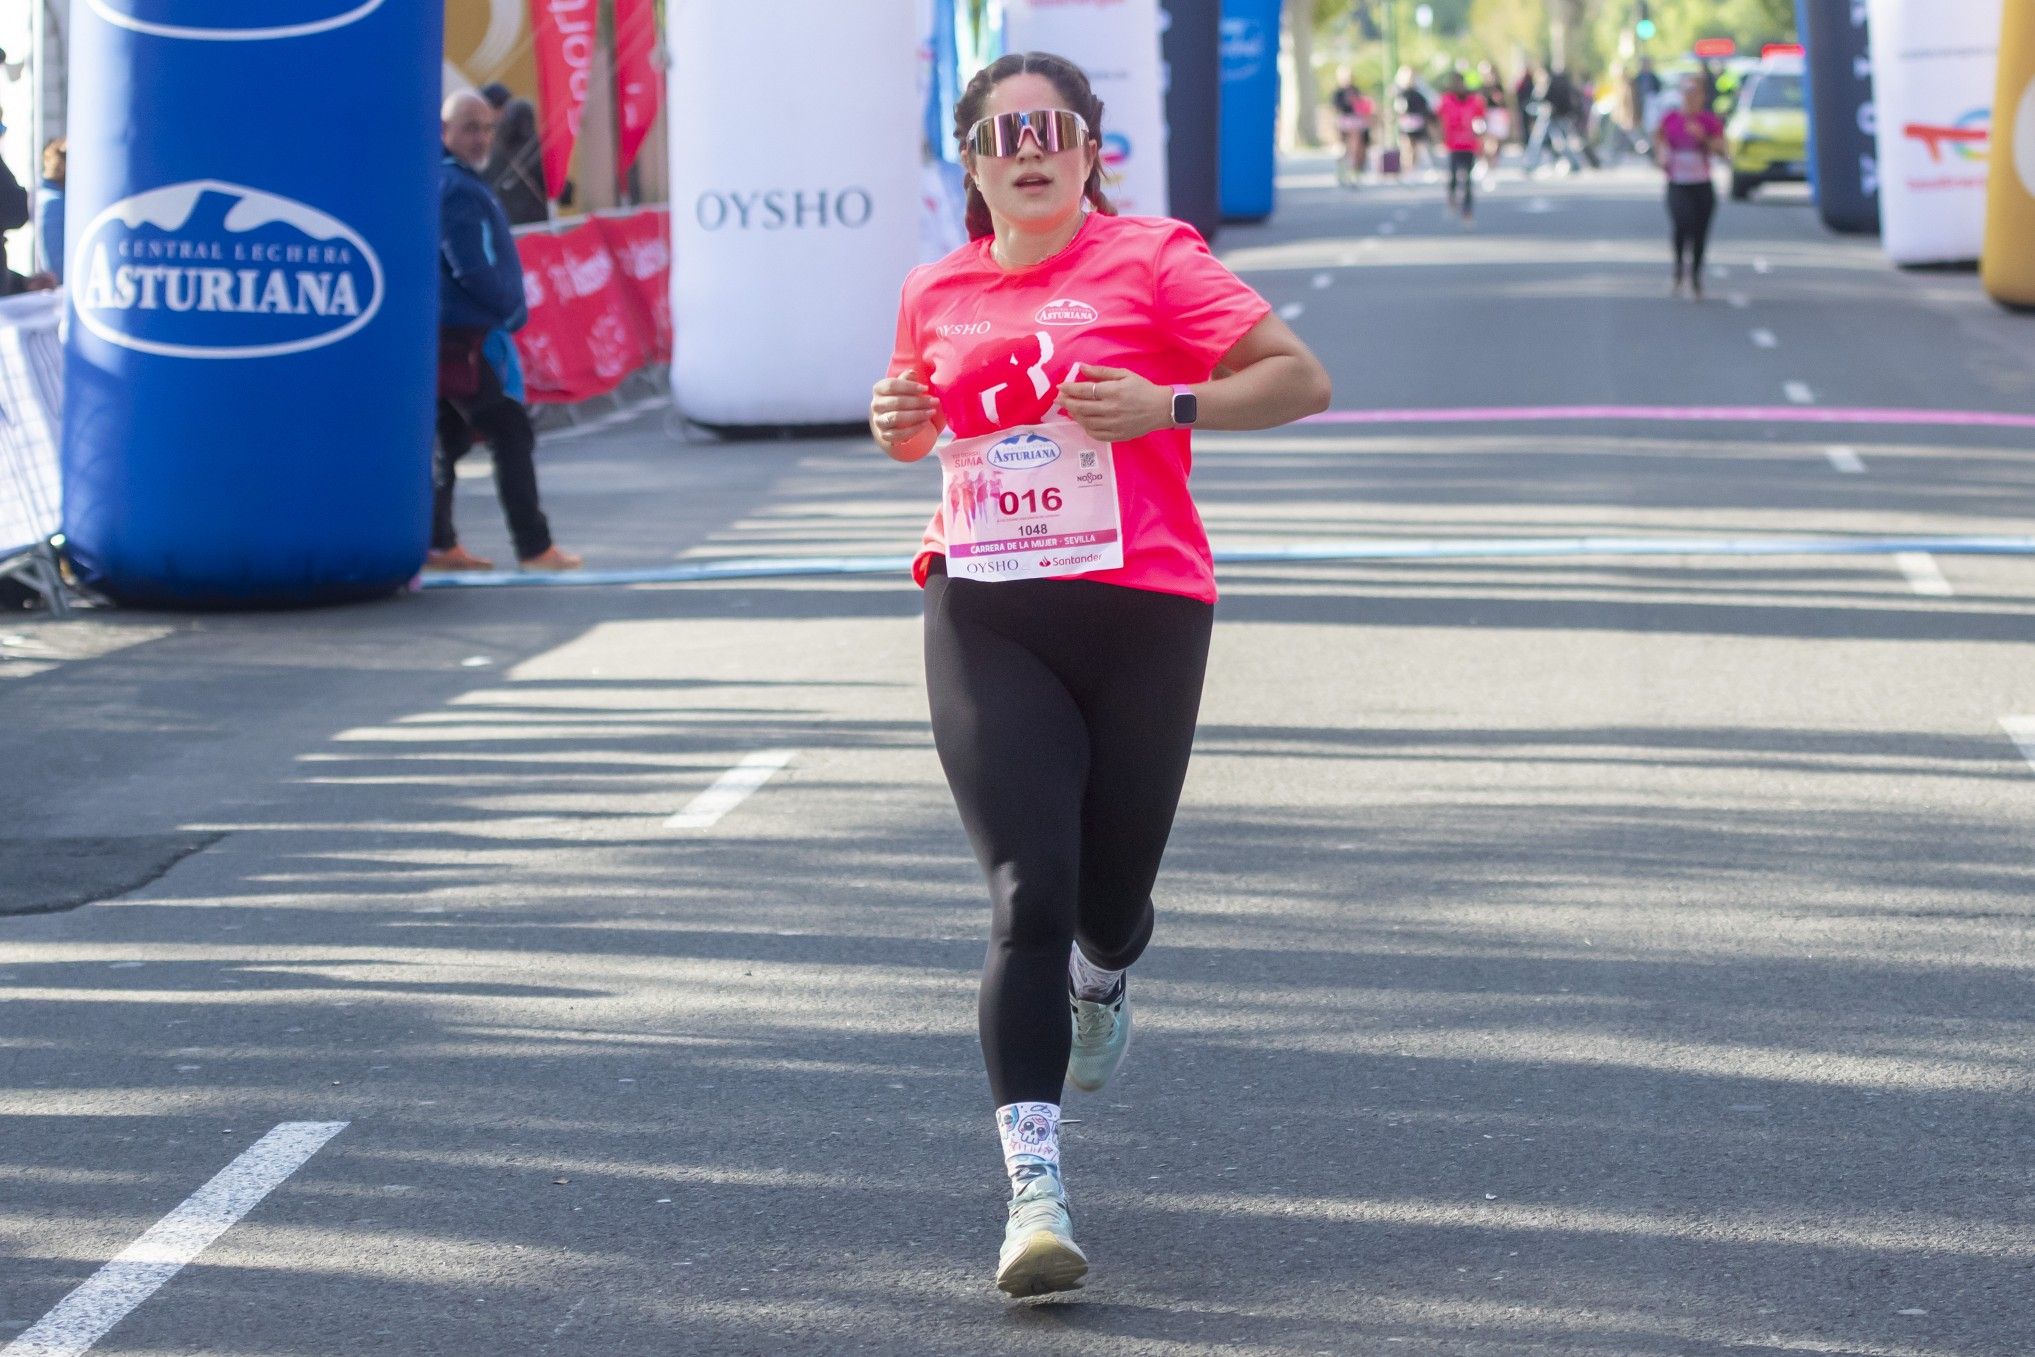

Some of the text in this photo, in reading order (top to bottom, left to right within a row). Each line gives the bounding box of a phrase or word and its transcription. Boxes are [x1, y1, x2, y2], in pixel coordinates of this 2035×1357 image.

[696, 184, 873, 233] OYSHO
[117, 239, 353, 265] CENTRAL LECHERA
[82, 240, 361, 317] ASTURIANA
[1040, 310, 1093, 321] ASTURIANA
[955, 458, 983, 468] SUMA
[993, 449, 1056, 463] ASTURIANA
[1000, 487, 1063, 515] 016
[1017, 523, 1048, 537] 1048
[970, 541, 1005, 554] CARRERA
[1007, 541, 1018, 551] DE
[1019, 539, 1030, 550] LA
[1031, 536, 1058, 549] MUJER
[1064, 534, 1096, 546] SEVILLA
[967, 559, 1019, 574] OYSHO
[1053, 553, 1103, 566] Santander
